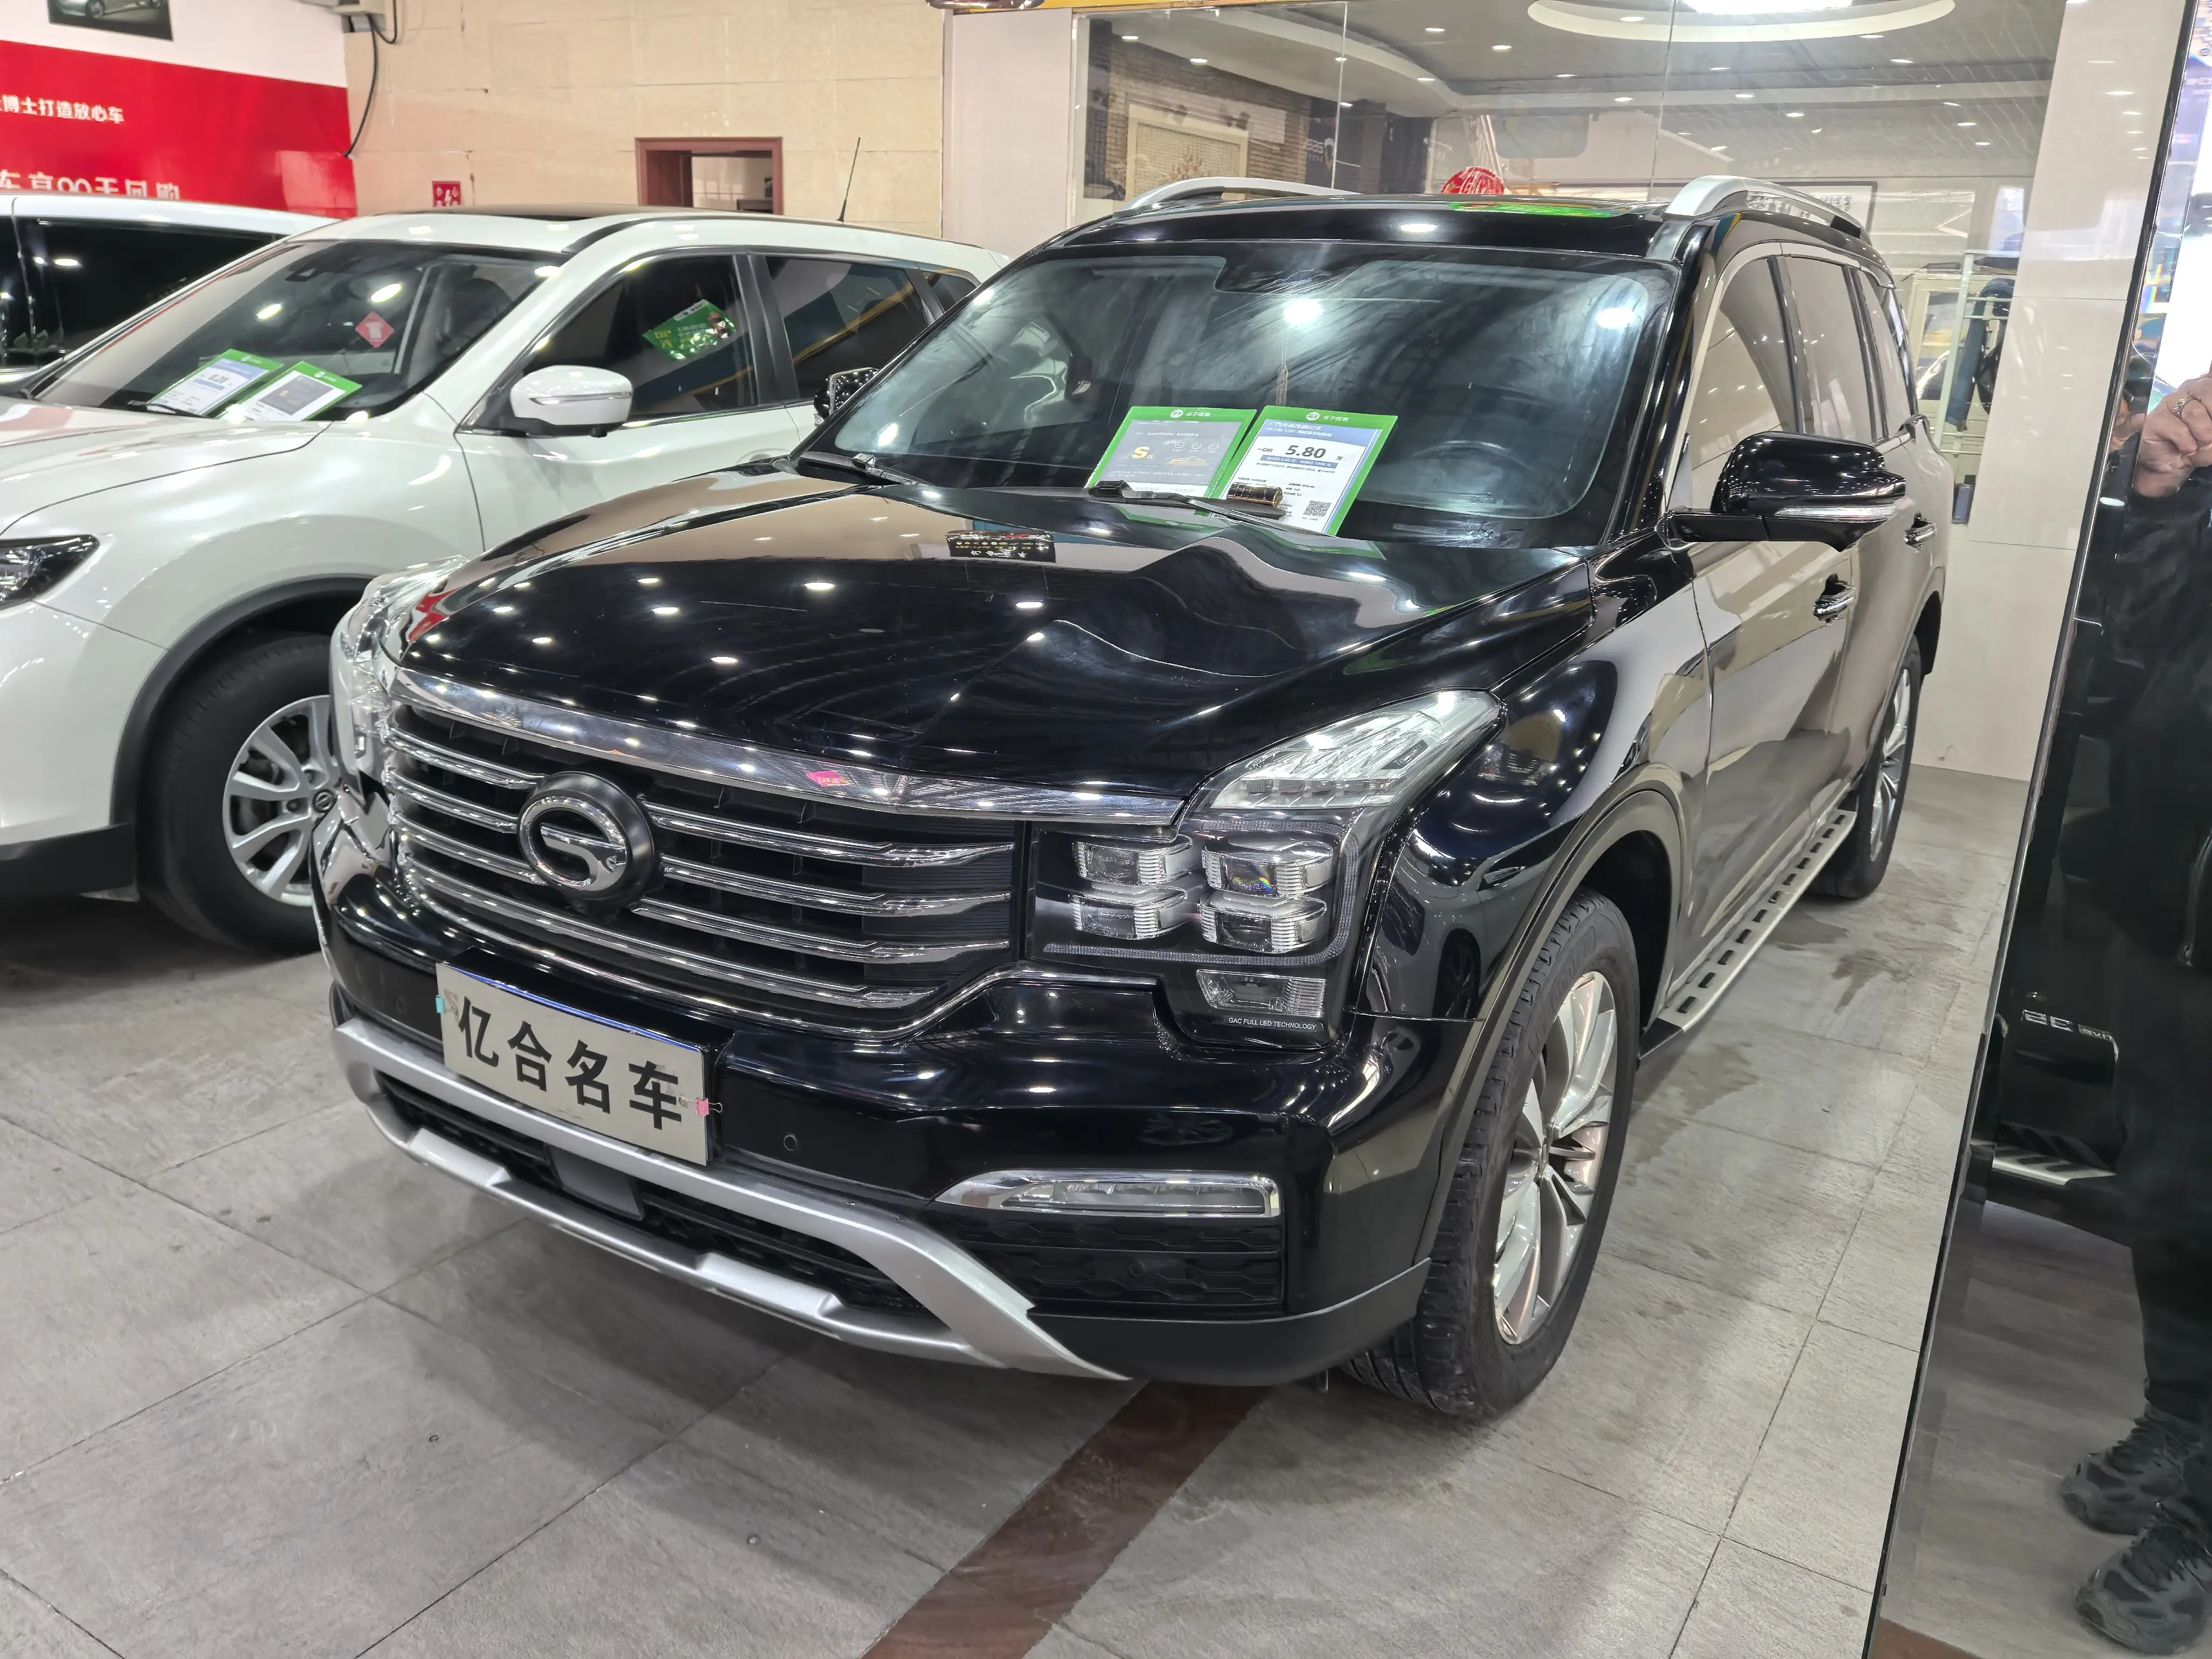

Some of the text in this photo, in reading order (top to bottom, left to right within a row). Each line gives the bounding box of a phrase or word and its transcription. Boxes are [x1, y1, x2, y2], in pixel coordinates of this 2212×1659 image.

[0, 94, 124, 124] 博士打造放心车
[1285, 445, 1326, 458] 5.80
[1273, 1021, 1317, 1030] TECHNOLOGY
[457, 996, 682, 1130] 亿合名车
